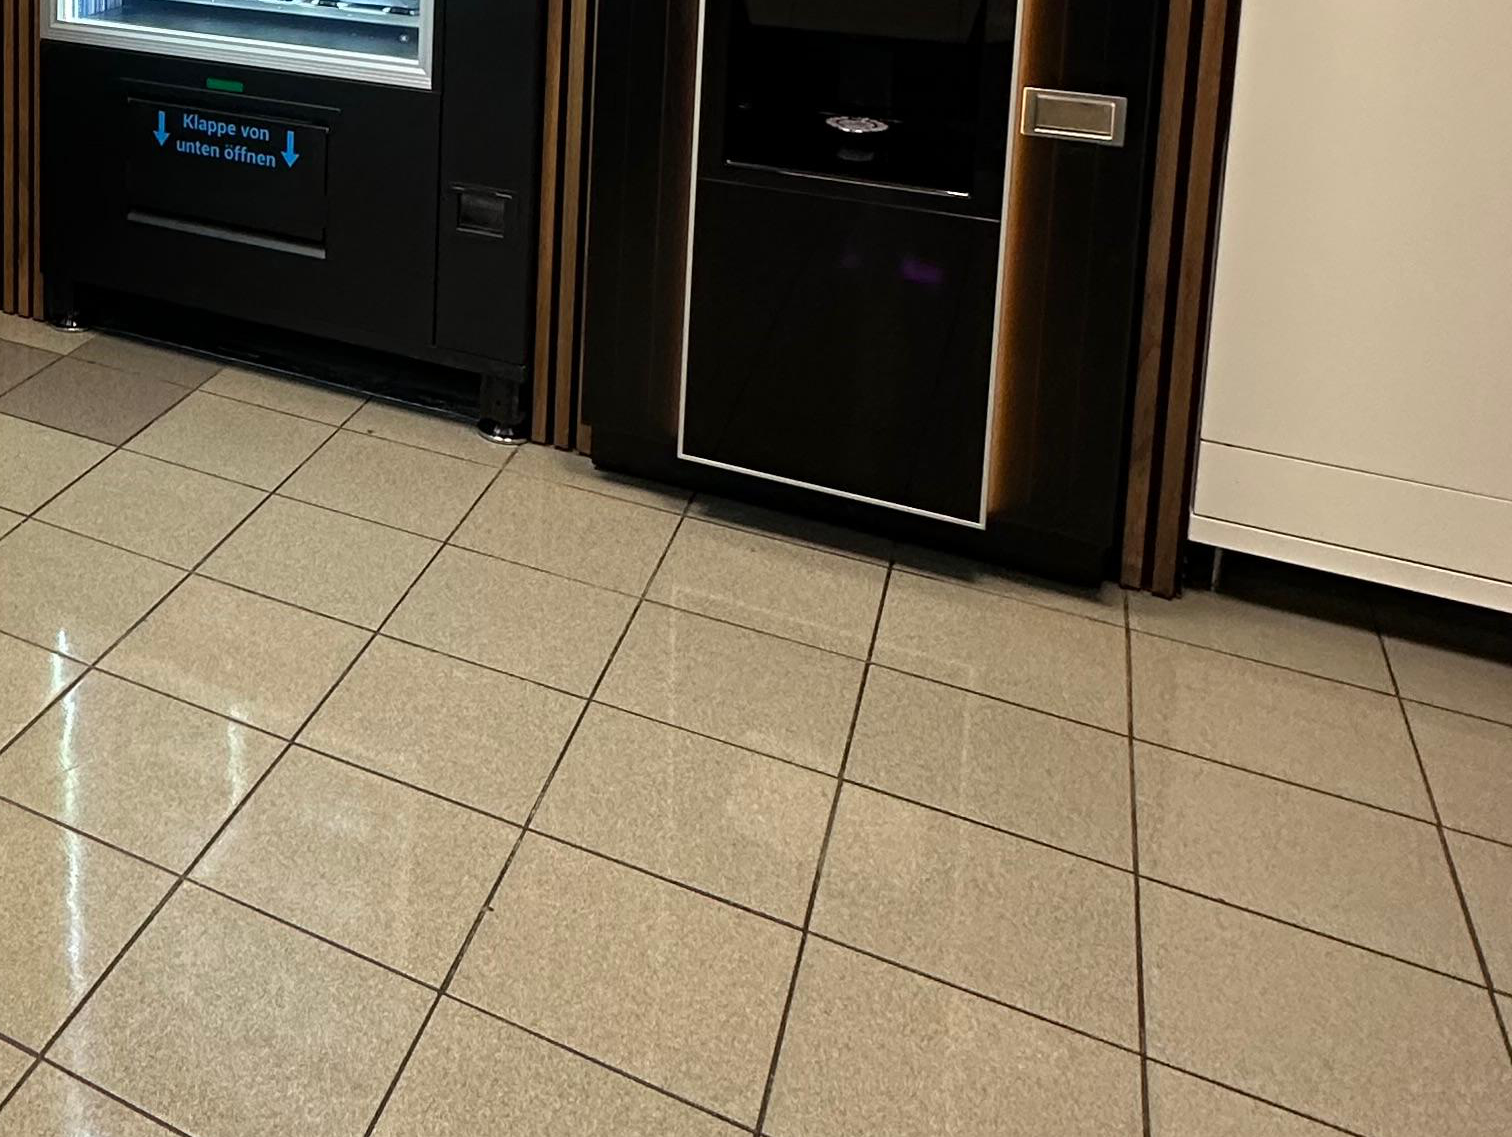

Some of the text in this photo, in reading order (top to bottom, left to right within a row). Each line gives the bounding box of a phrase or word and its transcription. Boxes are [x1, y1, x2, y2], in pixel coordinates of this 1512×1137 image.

[182, 113, 270, 142] Klappe von
[176, 139, 276, 169] unten öffnen
